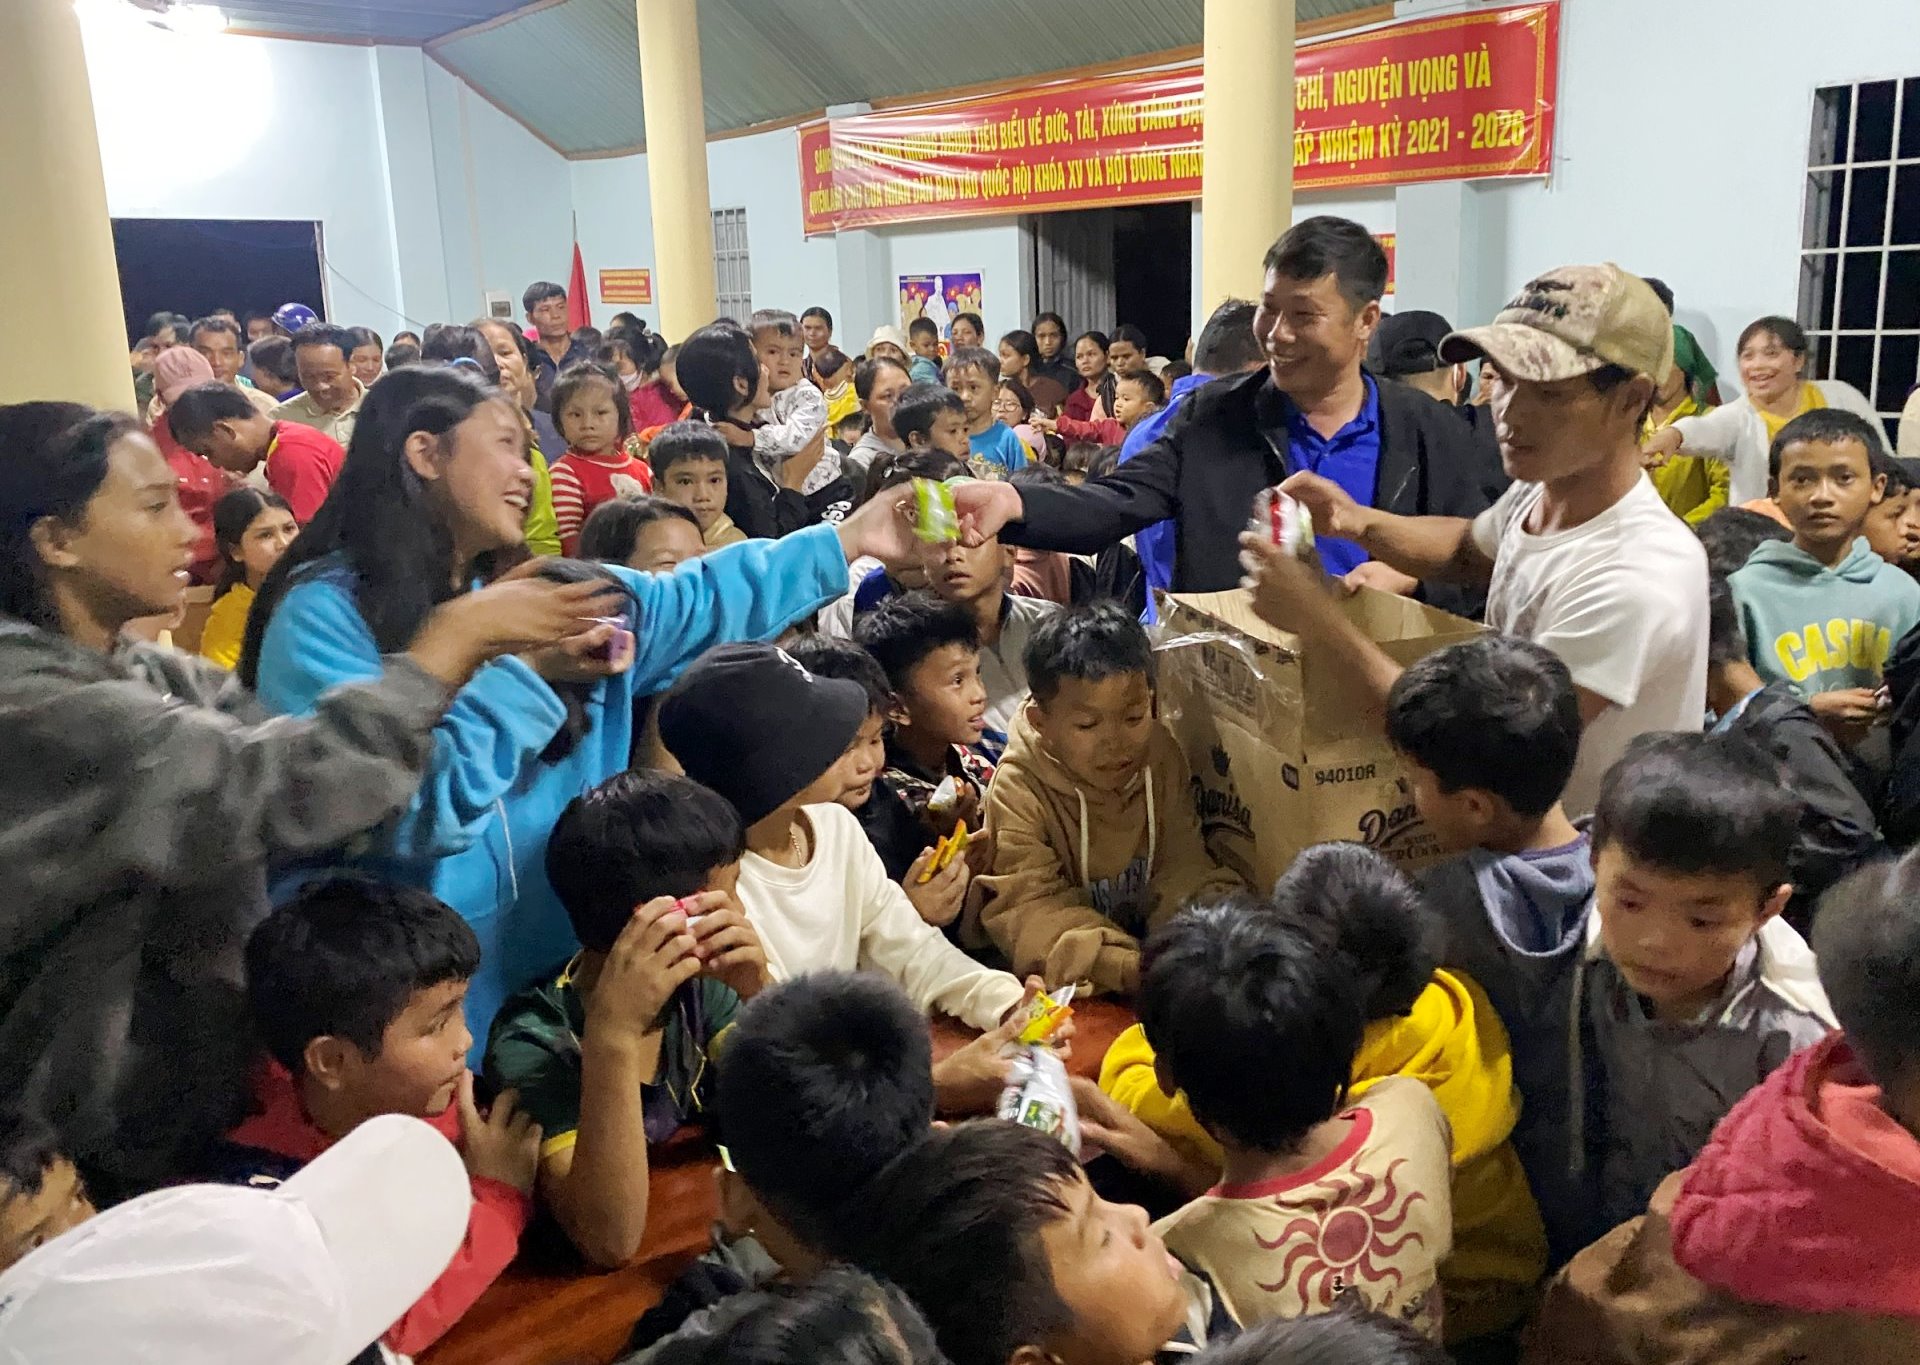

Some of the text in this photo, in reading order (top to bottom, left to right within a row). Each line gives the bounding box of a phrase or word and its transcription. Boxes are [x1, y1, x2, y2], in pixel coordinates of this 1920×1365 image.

[975, 118, 997, 152] TIÊU
[1000, 108, 1025, 150] BIỂU
[1028, 106, 1043, 146] VỀ
[1045, 108, 1072, 145] ĐỨC,
[1076, 103, 1098, 141] TÀI,
[1102, 99, 1136, 137] XỨNG
[1295, 67, 1328, 112] CHÍ,
[1333, 56, 1403, 108] NGUYỆN
[1408, 54, 1458, 103] VỌNG
[1463, 42, 1491, 89] VÀ
[981, 158, 1009, 200] QUỐC
[1013, 159, 1031, 200] HỘI
[1034, 156, 1065, 193] KHÓA
[1067, 159, 1083, 189] XV
[1086, 151, 1103, 187] VÀ
[1106, 149, 1127, 191] HỘI
[1130, 141, 1166, 183] ĐỒNG
[1293, 121, 1315, 166] ẤP
[1319, 119, 1375, 169] NHIỆM
[1379, 115, 1402, 158] KỲ
[1406, 117, 1450, 155] 2021
[1456, 131, 1465, 139] -
[1471, 109, 1525, 149] 2026
[1314, 763, 1377, 786] 94010R
[1357, 803, 1418, 846] Dan
